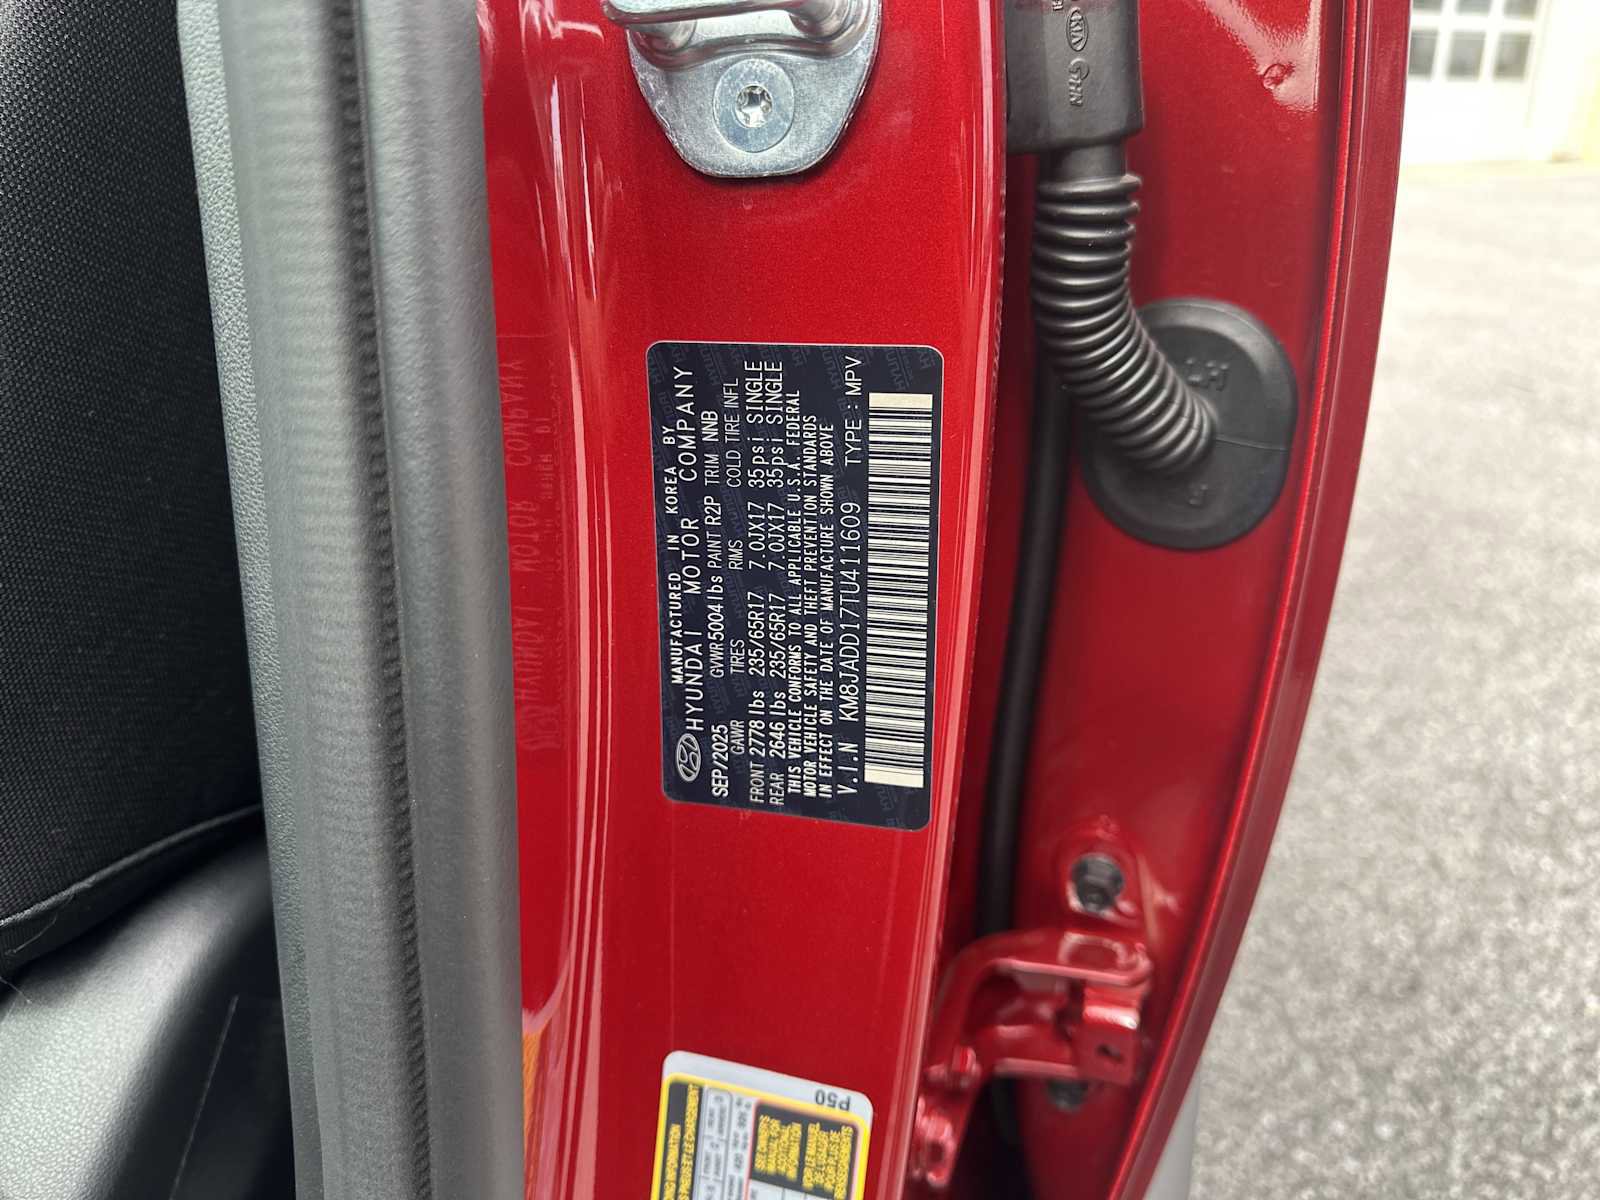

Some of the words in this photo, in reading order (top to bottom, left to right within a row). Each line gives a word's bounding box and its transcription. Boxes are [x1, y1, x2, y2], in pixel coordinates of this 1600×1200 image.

[1068, 12, 1085, 47] KIA
[723, 378, 739, 408] INFL
[744, 361, 764, 424] SINGLE
[764, 362, 783, 425] SINGLE
[845, 356, 862, 396] MPV
[662, 426, 675, 444] BY
[673, 366, 697, 482] COMPANY
[701, 410, 718, 442] NNB
[724, 414, 740, 443] TIRE
[786, 390, 800, 446] FEDERAL
[803, 416, 817, 486] STANDARDS
[819, 424, 833, 466] ABOVE
[704, 454, 720, 486] TRIM
[726, 450, 741, 488] COLD
[787, 457, 801, 502] U.S.A.
[664, 466, 678, 514] KOREA
[820, 474, 834, 515] SHOWN
[704, 496, 722, 526] R2P
[667, 535, 679, 550] IN
[706, 531, 722, 568] PAINT
[748, 501, 766, 570] 7.0JX17
[768, 502, 785, 571] 7.0JX17
[788, 510, 802, 585] APPLICABLE
[804, 495, 817, 571] PREVENTION
[681, 518, 701, 594] MOTOR
[728, 540, 743, 570] RIMS
[820, 524, 834, 611] MANUFACTURE
[788, 594, 802, 615] ALL
[804, 579, 817, 615] THEFT
[839, 502, 860, 722] KM8JADD17TU411609
[668, 573, 683, 684] MANUFACTURED
[748, 591, 765, 677] 235/65R17
[768, 593, 786, 679] 235/65R17
[788, 623, 802, 636] TO
[804, 624, 817, 646] AND
[820, 618, 833, 634] OF
[710, 642, 724, 678] GVWR
[730, 640, 745, 674] TIRES
[788, 645, 802, 702] CONFORMS
[804, 652, 817, 696] SAFETY
[820, 642, 833, 672] DATE
[684, 631, 704, 730] HYUNDAI
[819, 680, 833, 701] THE
[730, 720, 745, 755] GAWR
[788, 708, 802, 759] VEHICLE
[804, 704, 817, 754] VEHICLE
[819, 710, 833, 725] ON
[711, 724, 729, 797] SEP/2025
[819, 732, 832, 777] EFFECT
[749, 761, 764, 804] FRONT
[769, 772, 784, 805] REAR
[788, 766, 802, 794] THIS
[804, 761, 817, 797] MOTOR
[819, 784, 832, 798] IN
[815, 1089, 851, 1111] P50
